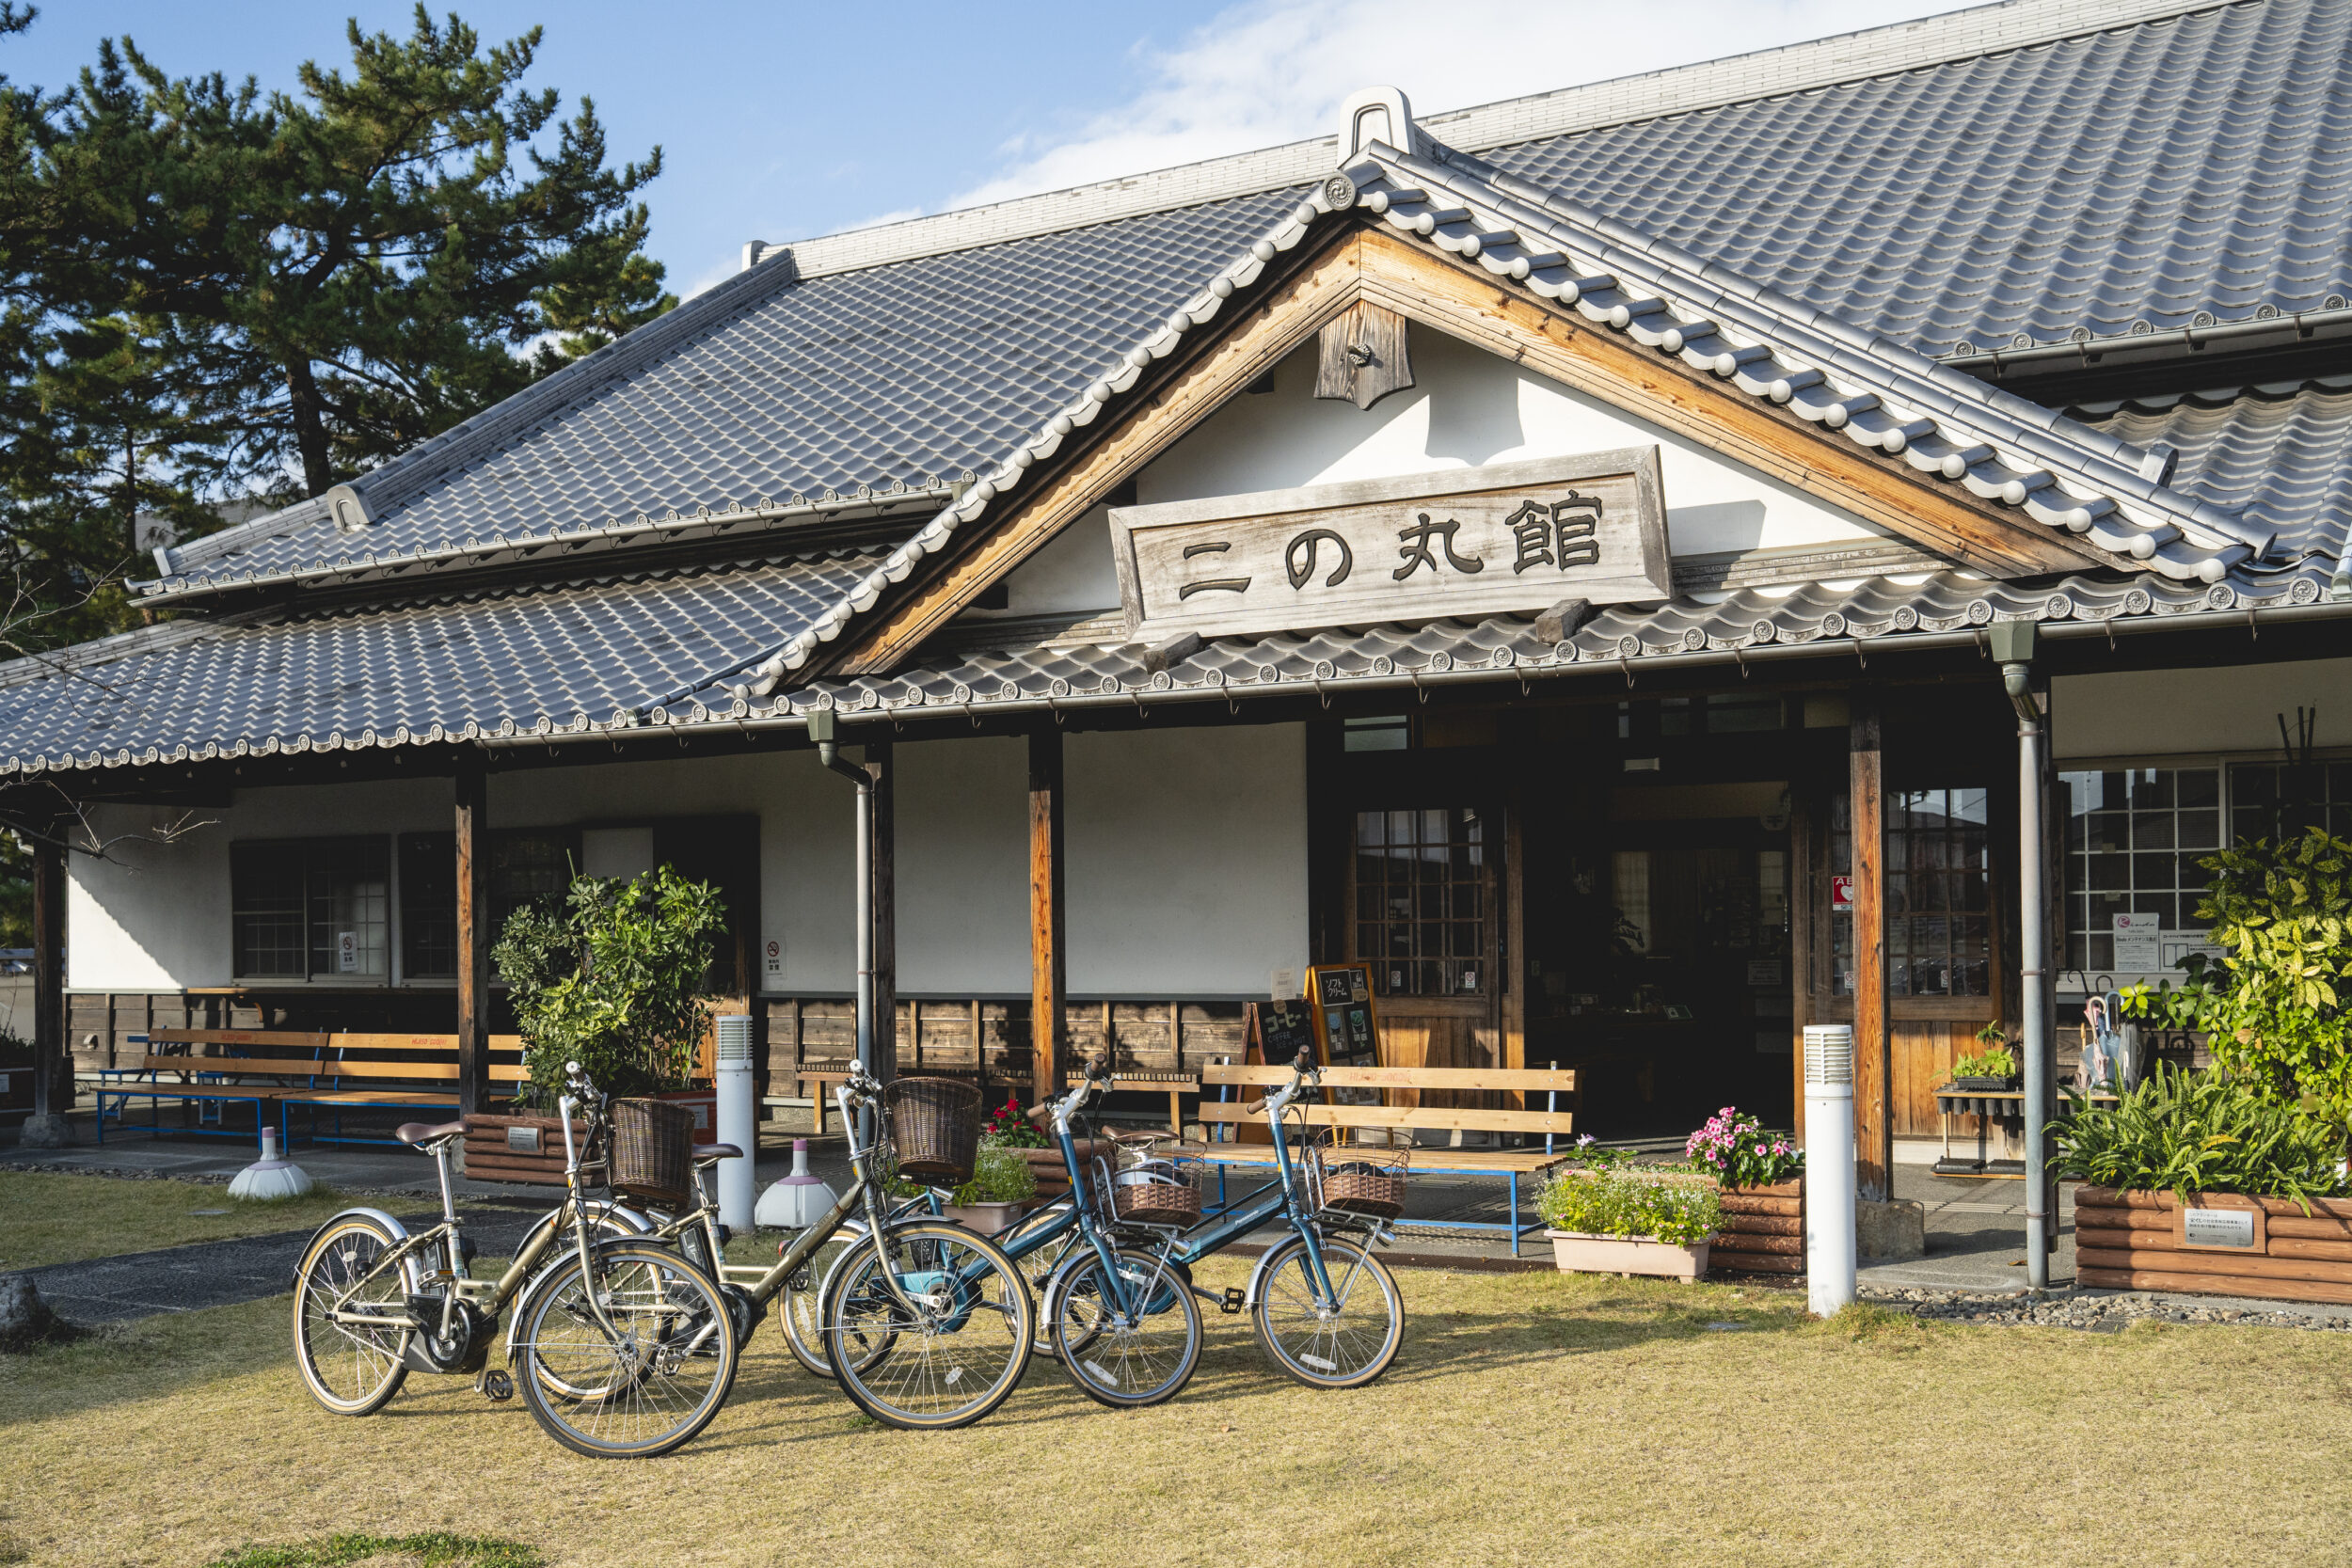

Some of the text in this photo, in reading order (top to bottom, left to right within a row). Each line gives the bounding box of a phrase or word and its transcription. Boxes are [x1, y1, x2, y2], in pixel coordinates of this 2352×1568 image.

[1179, 489, 1602, 602] 二の丸館
[1326, 978, 1343, 989] ソフト
[1327, 988, 1347, 997] クリーム
[1264, 1011, 1302, 1033] コーヒー
[1267, 1031, 1292, 1043] COFFEE
